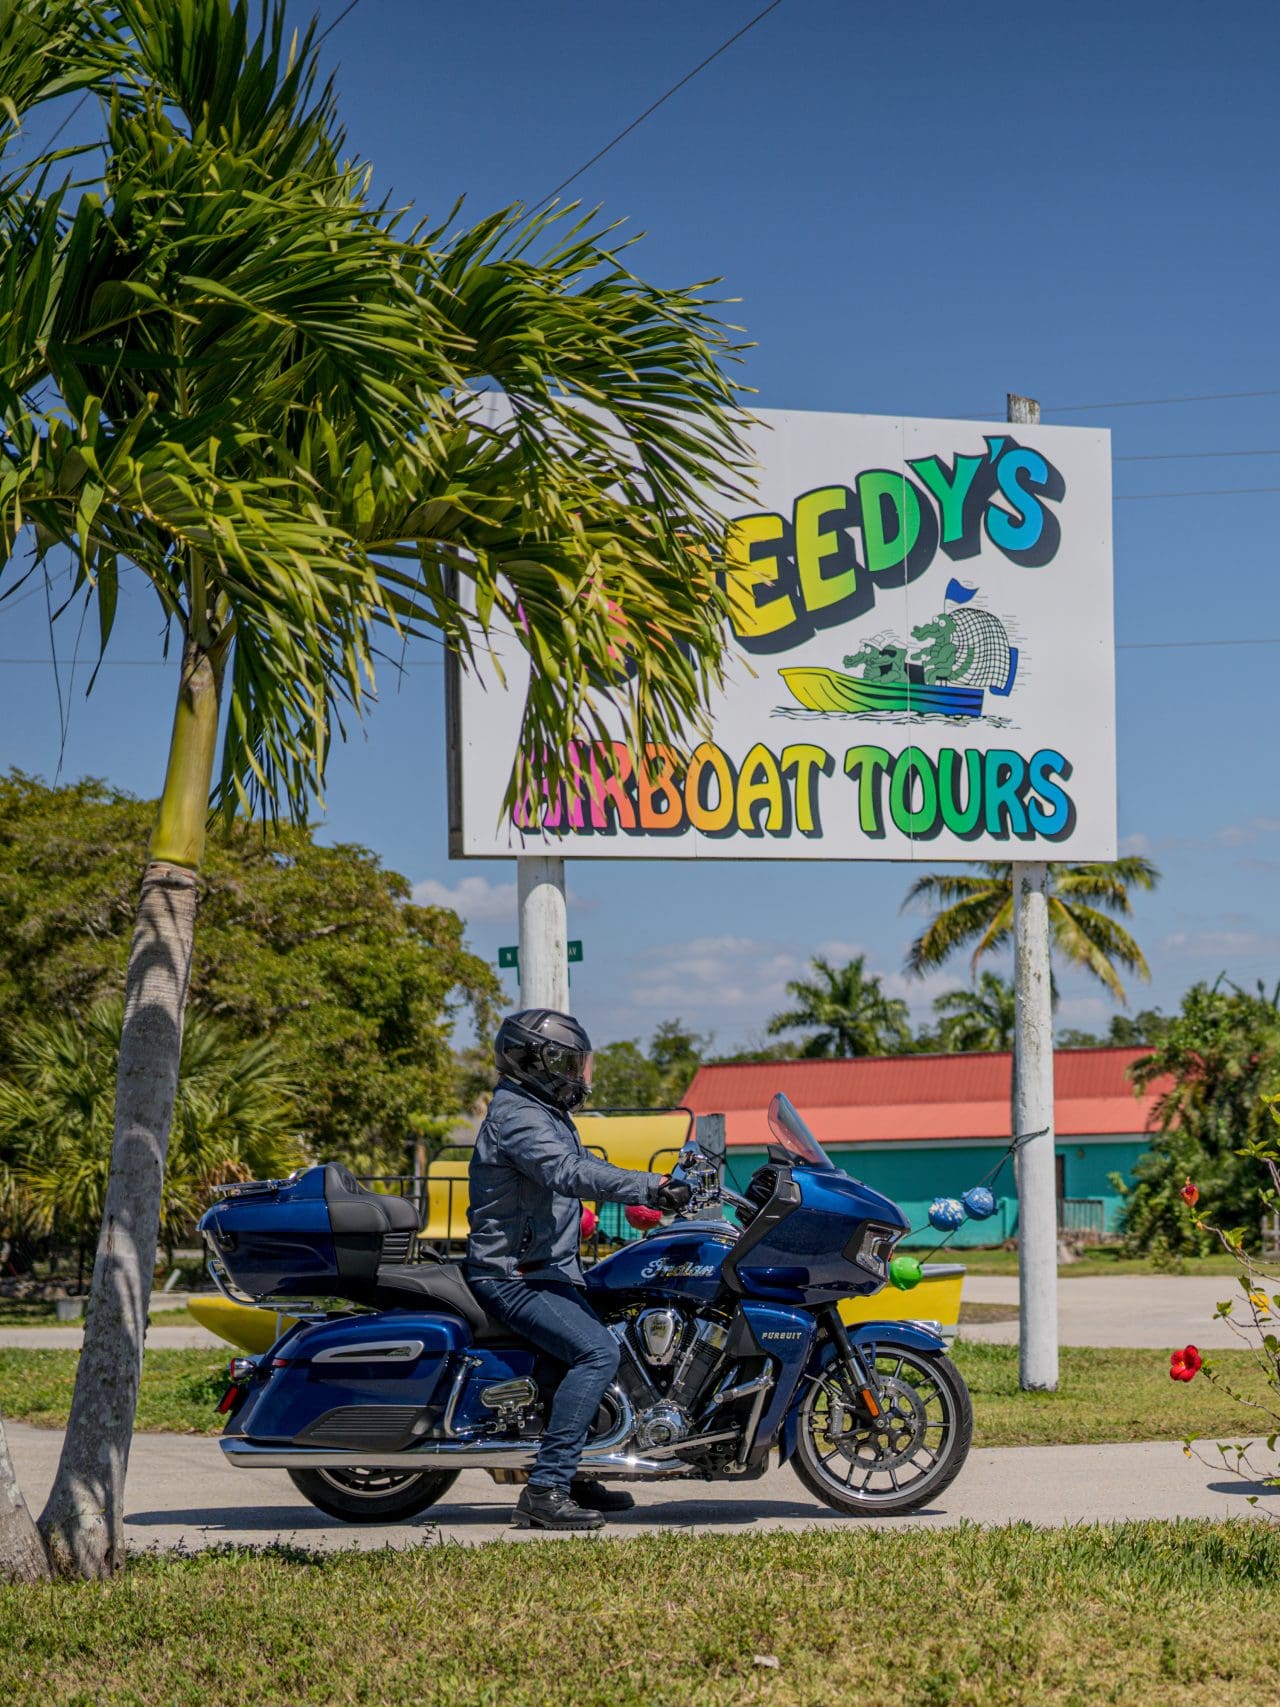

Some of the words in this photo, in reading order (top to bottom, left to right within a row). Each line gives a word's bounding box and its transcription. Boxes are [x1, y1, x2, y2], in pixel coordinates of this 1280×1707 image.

[518, 434, 1067, 688] EEDY'S
[844, 745, 1077, 843] TOURS
[640, 1257, 716, 1279] Indian
[761, 1331, 802, 1340] PURSUIT
